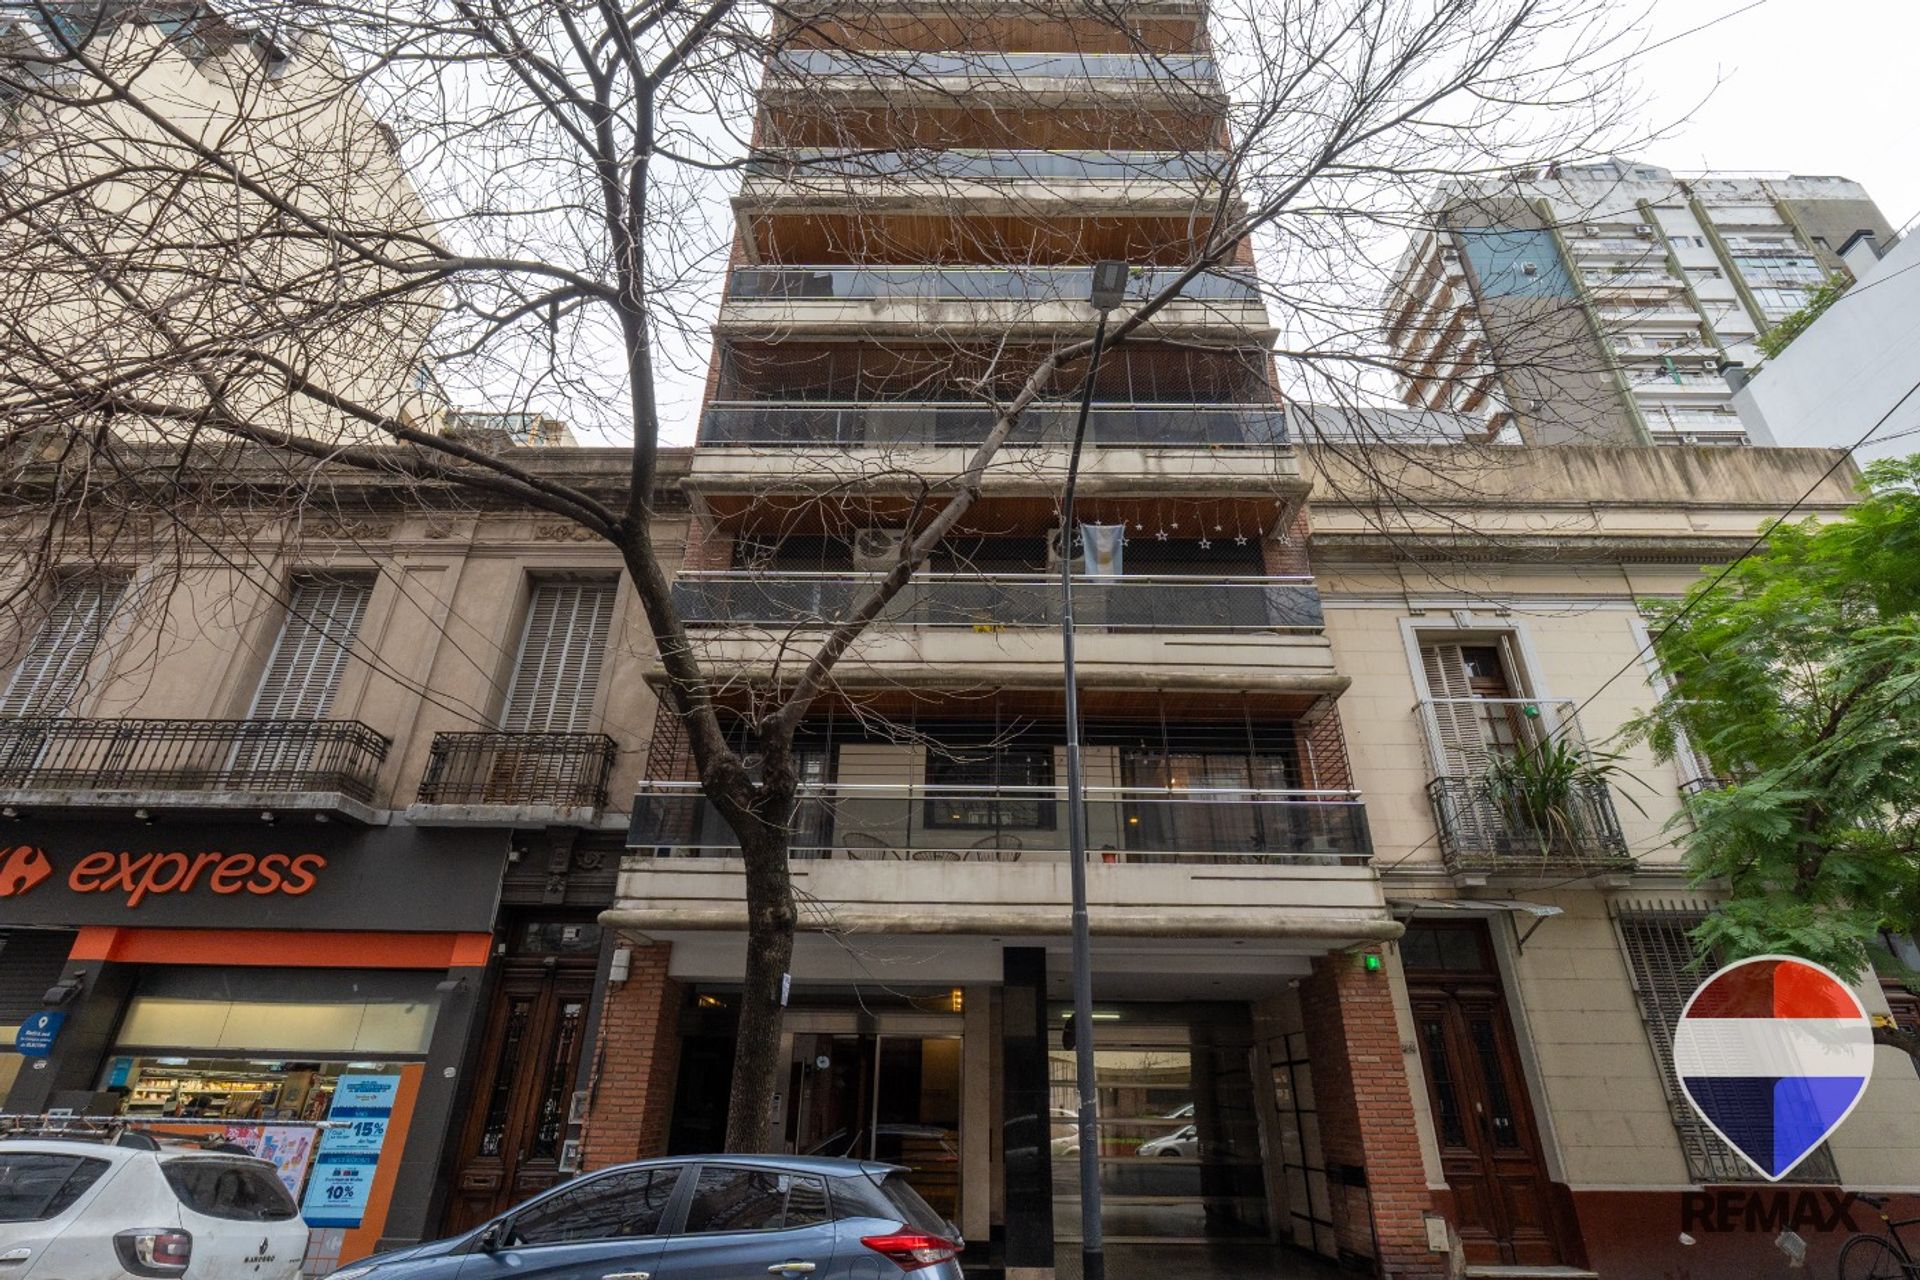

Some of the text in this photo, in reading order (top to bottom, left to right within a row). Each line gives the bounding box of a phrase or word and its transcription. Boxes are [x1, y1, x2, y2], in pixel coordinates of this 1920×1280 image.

[67, 851, 327, 908] express
[354, 1122, 384, 1137] 15%
[326, 1185, 354, 1199] 10%
